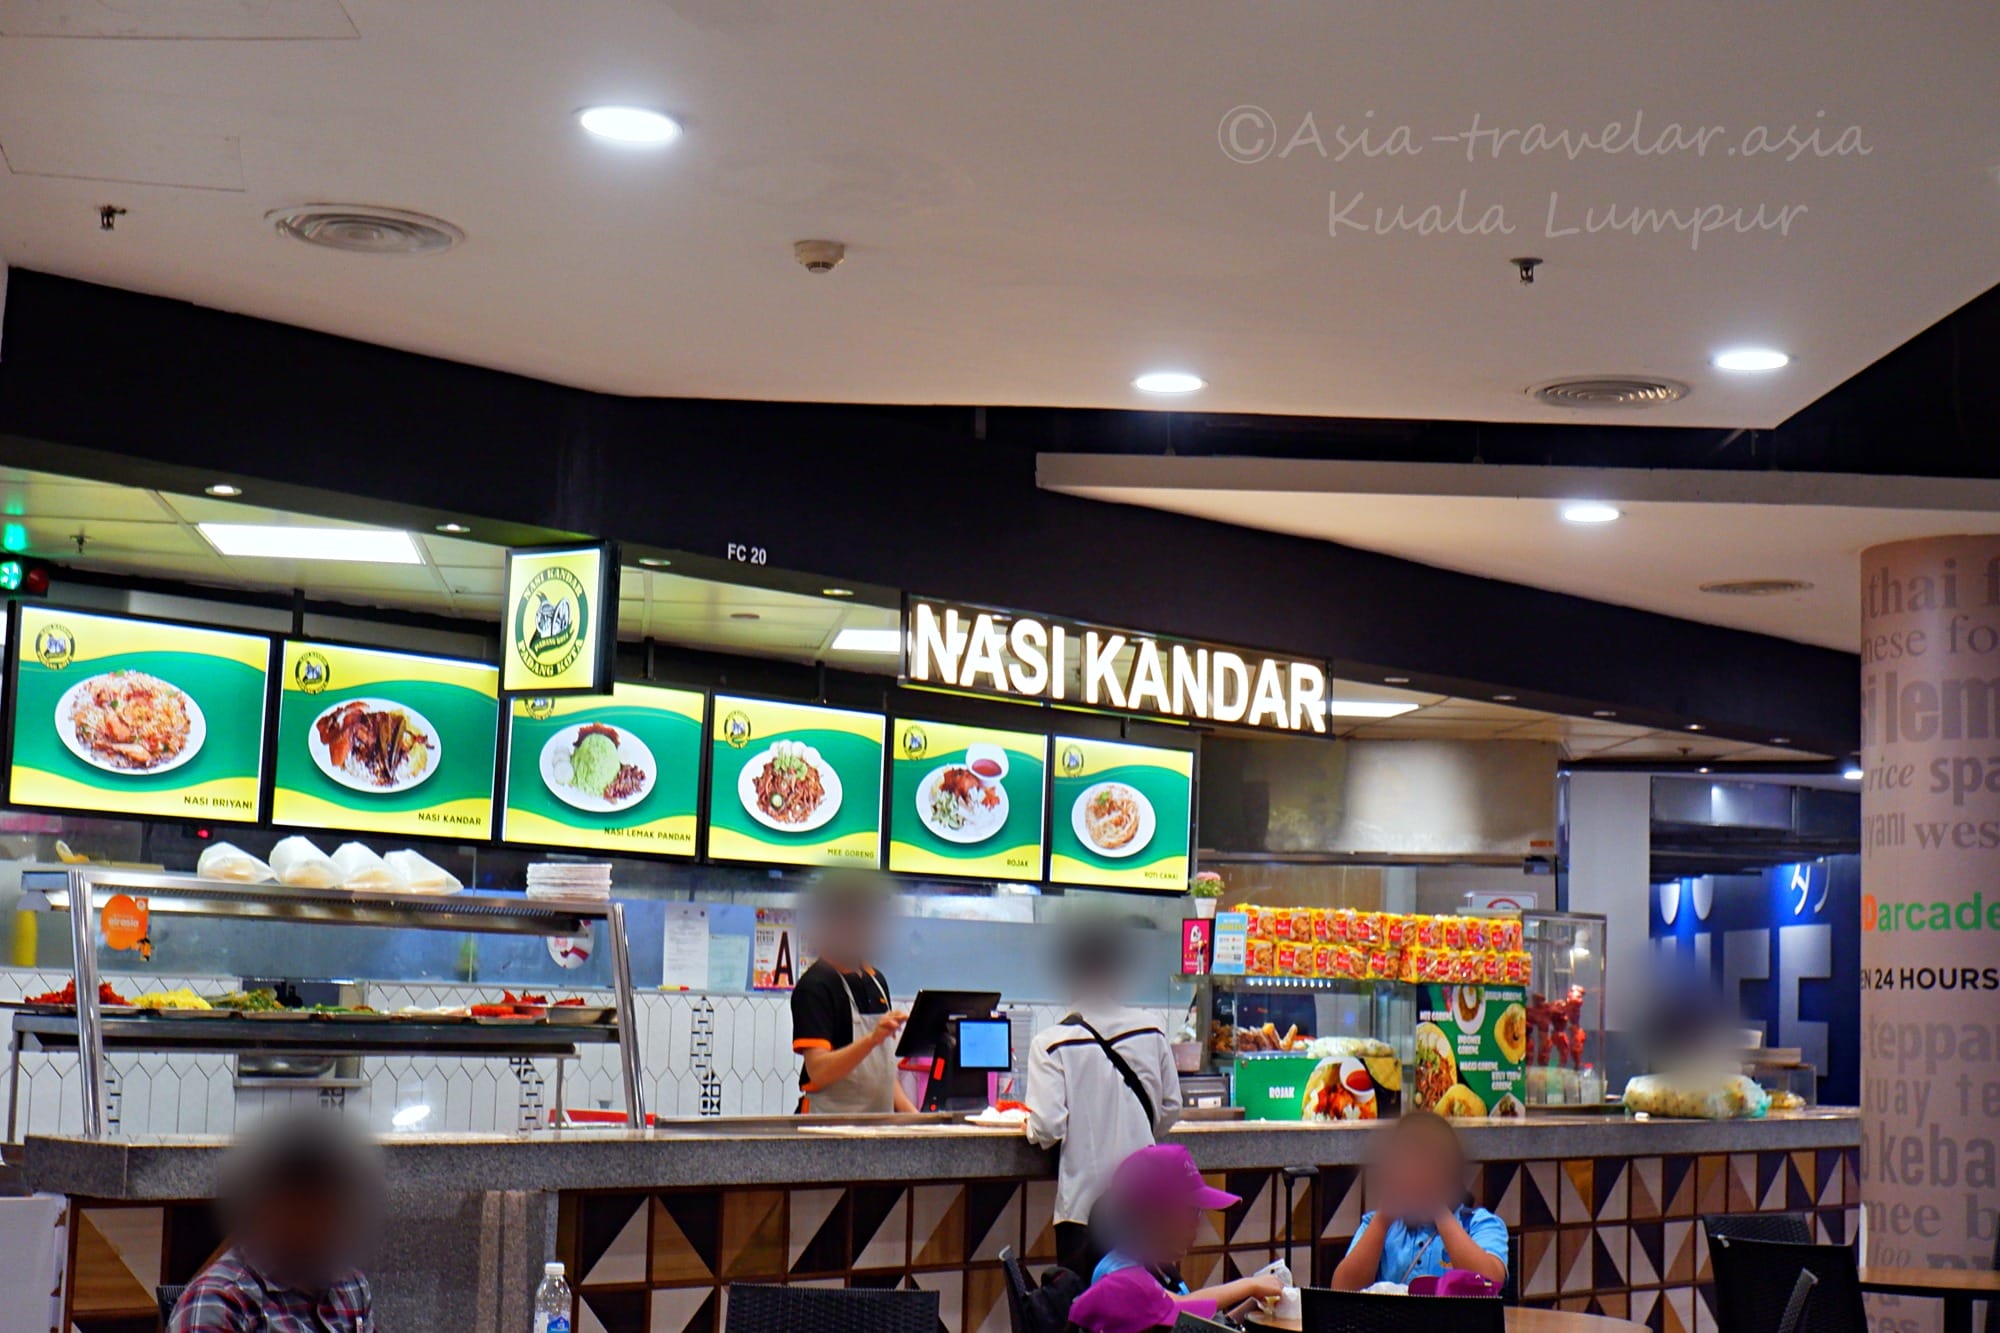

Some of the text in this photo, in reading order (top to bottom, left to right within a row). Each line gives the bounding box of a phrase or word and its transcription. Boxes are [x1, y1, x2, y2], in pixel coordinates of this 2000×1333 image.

[728, 542, 767, 566] FC 20
[523, 566, 584, 601] NASI KANDAR
[1868, 558, 1957, 618] thai
[517, 640, 584, 677] PADANG KOTA
[911, 603, 1327, 734] NASI KANDAR
[1869, 756, 1914, 792] rice
[184, 795, 253, 810] NASI BRIYANI
[418, 812, 481, 827] NASI KANDAR
[604, 826, 692, 842] NASI LEMAK PANDAN
[827, 849, 875, 859] MEE GORENG
[1006, 859, 1028, 867] ROJAK
[773, 930, 795, 986] A
[1875, 968, 1894, 990] 24
[1900, 967, 1999, 990] HOURS
[1866, 1012, 2000, 1075] teppa
[1269, 1086, 1295, 1099] ROJAK
[1880, 1121, 1996, 1189] keba
